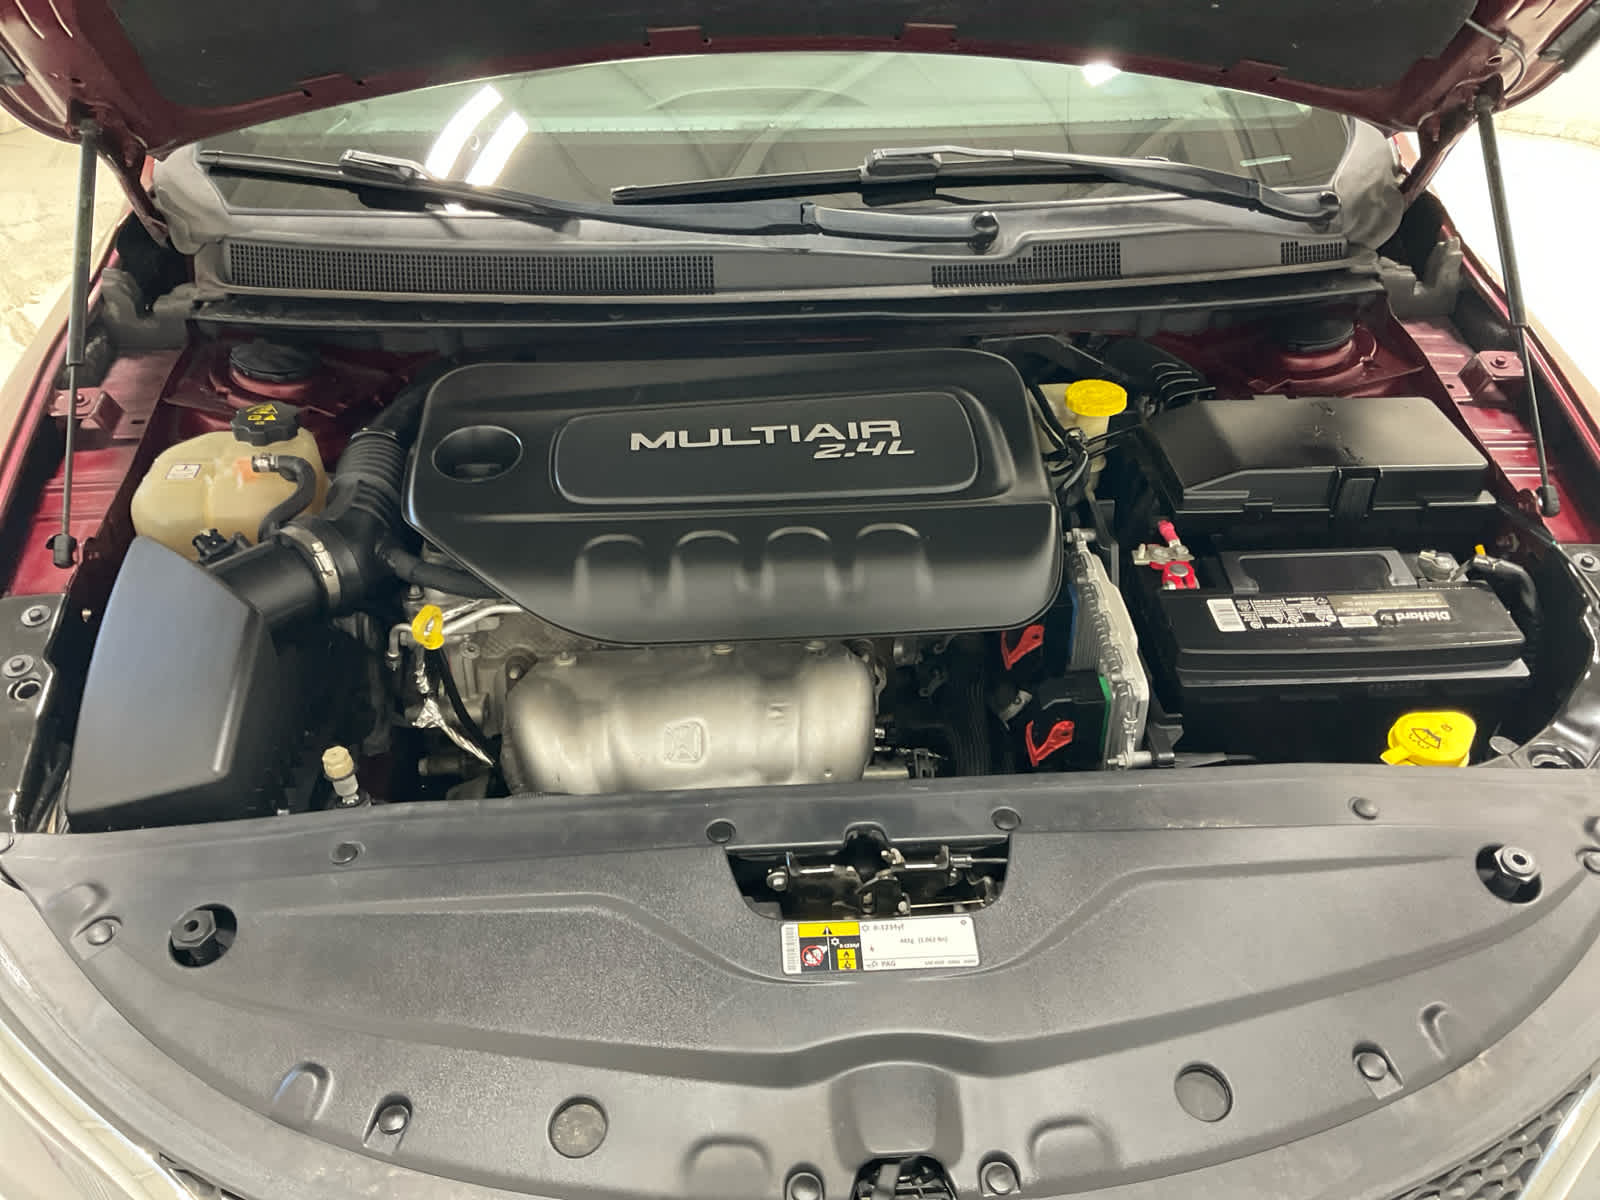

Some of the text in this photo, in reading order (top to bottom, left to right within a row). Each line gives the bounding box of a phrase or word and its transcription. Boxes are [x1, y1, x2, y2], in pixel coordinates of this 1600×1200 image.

[630, 420, 901, 451] MULTIAIR
[812, 439, 916, 459] 2.4L
[1395, 611, 1450, 622] DieHard
